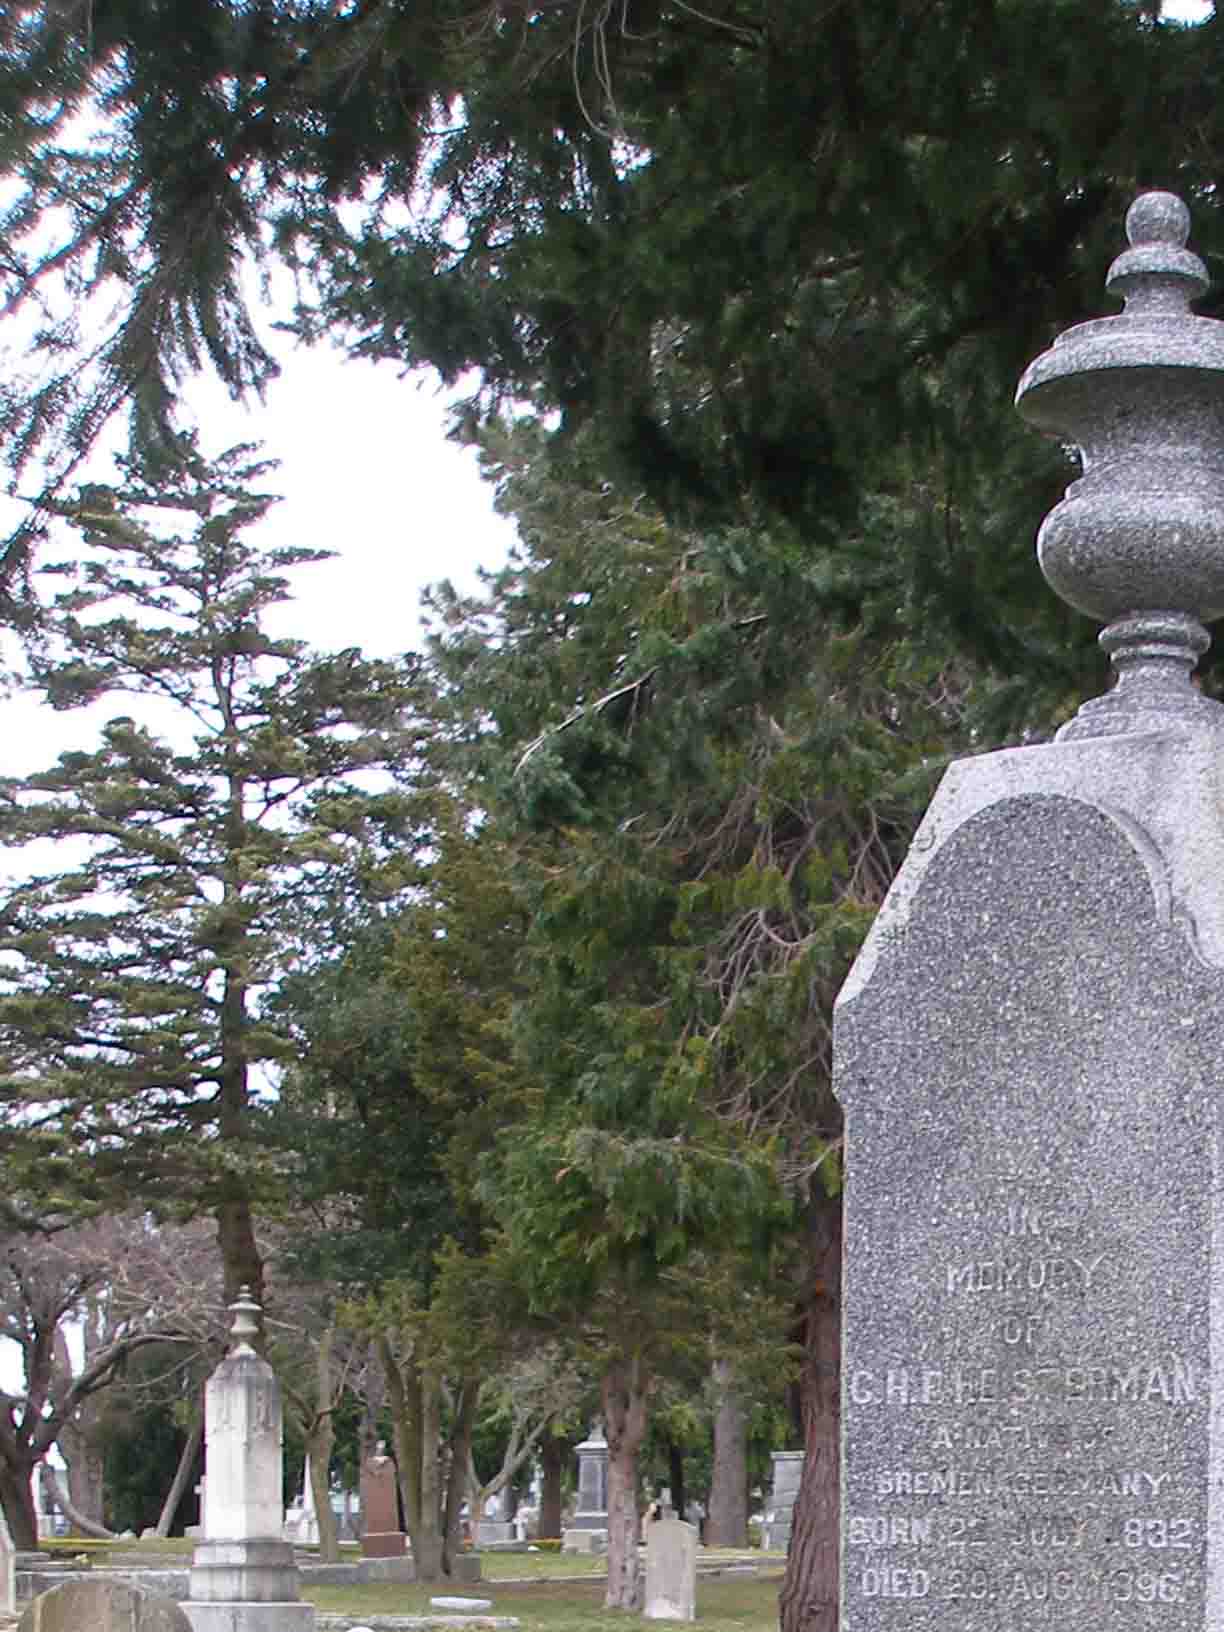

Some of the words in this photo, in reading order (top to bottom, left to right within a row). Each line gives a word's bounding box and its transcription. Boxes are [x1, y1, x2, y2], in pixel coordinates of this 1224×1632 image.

[946, 1254, 1103, 1293] MEMORY
[1002, 1314, 1042, 1345] OF
[861, 1568, 931, 1600] DIED
